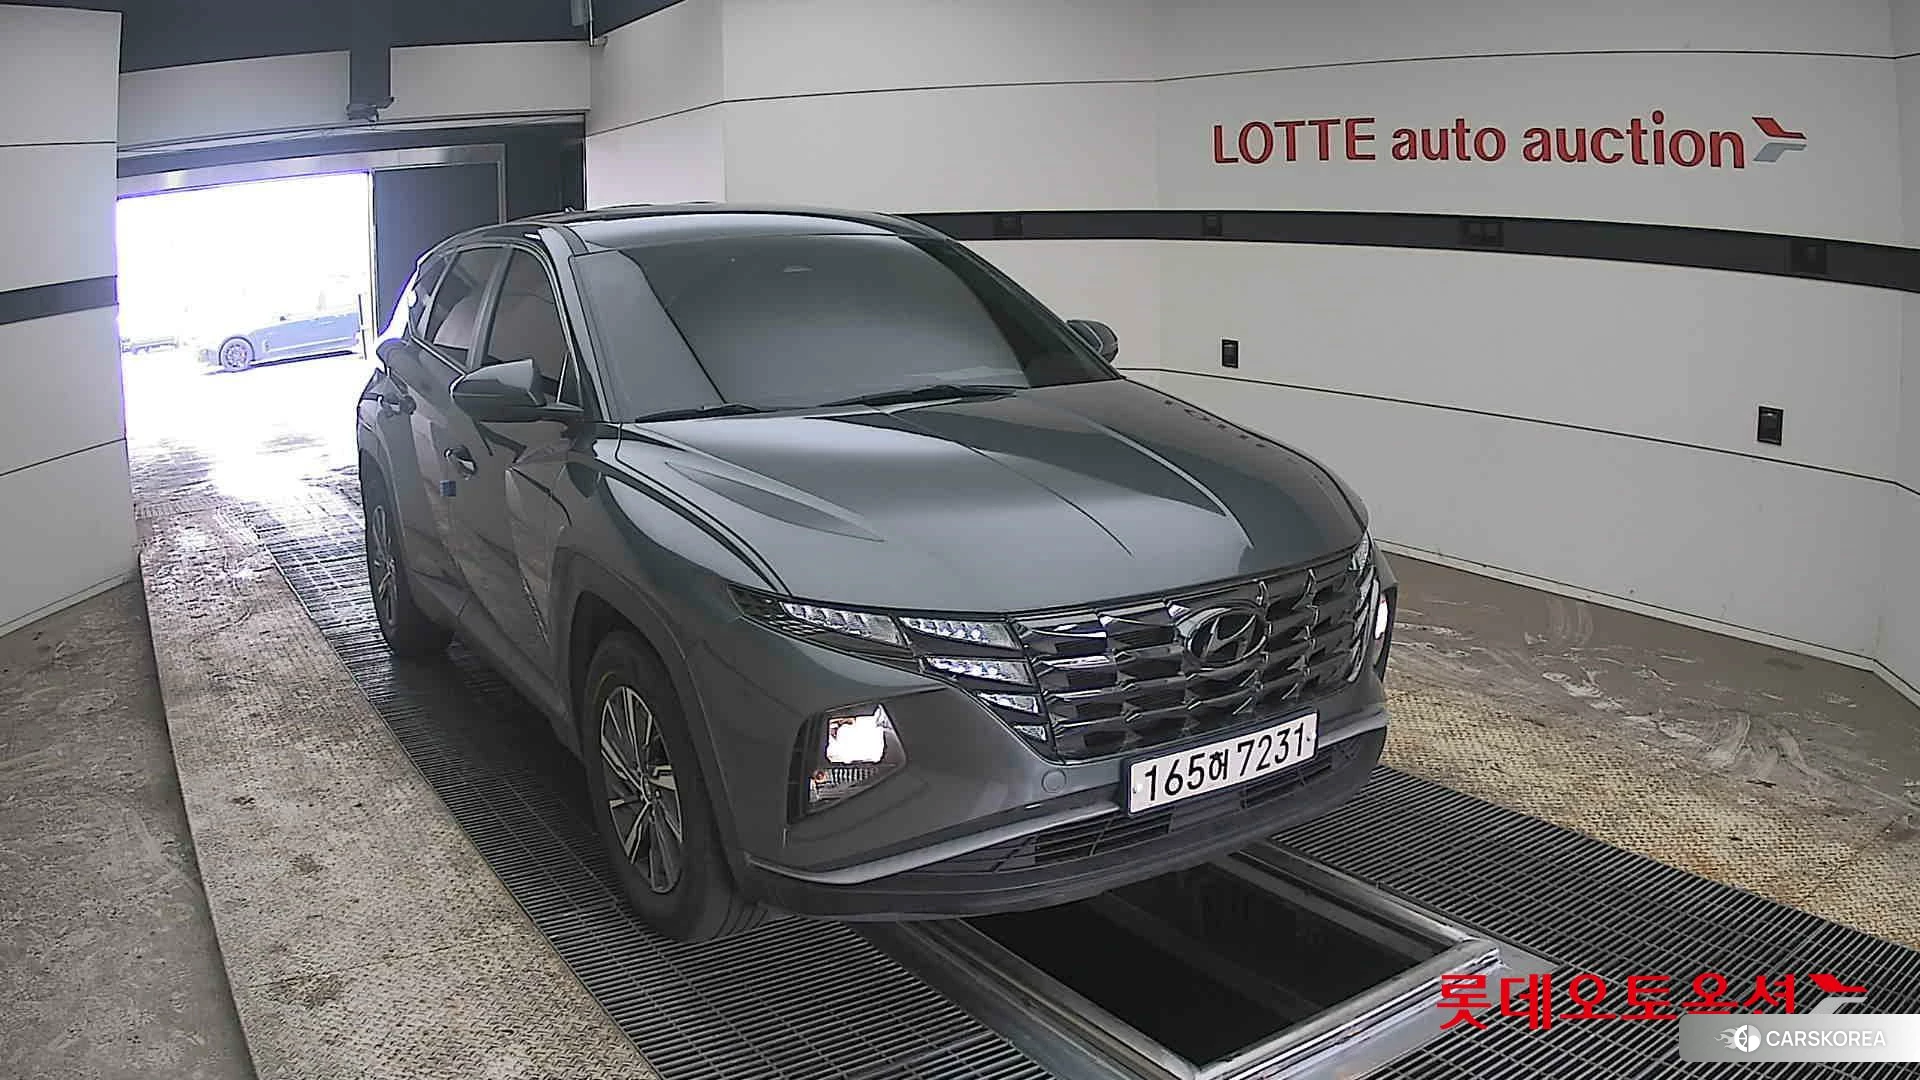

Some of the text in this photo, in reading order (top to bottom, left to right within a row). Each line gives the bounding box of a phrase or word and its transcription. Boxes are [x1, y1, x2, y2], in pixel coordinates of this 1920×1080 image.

[1213, 110, 1745, 168] LOTTE auto auction
[1145, 723, 1304, 801] 165허 7231
